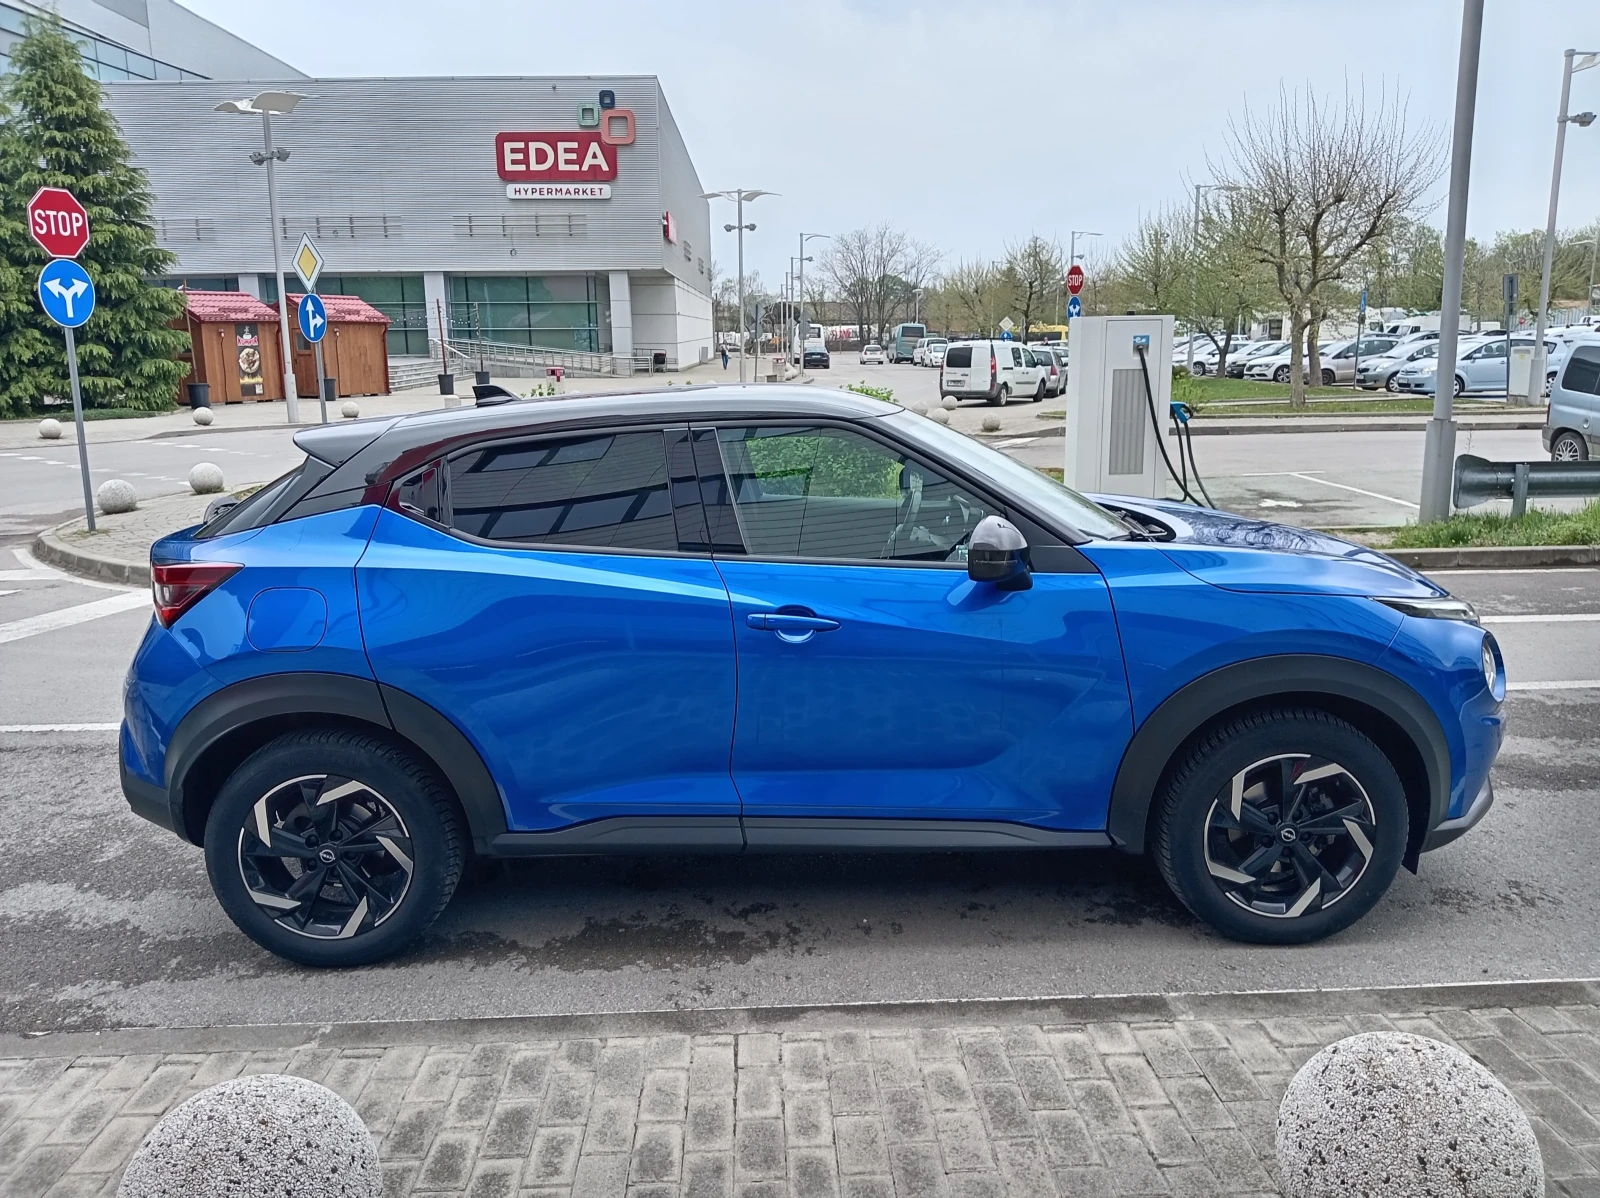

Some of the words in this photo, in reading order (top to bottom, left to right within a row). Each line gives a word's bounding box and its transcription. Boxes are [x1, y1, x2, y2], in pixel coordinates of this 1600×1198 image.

[503, 141, 610, 172] EDEA
[513, 187, 604, 196] HYPERMARKET
[34, 208, 83, 237] STOP
[1068, 274, 1083, 286] STOP
